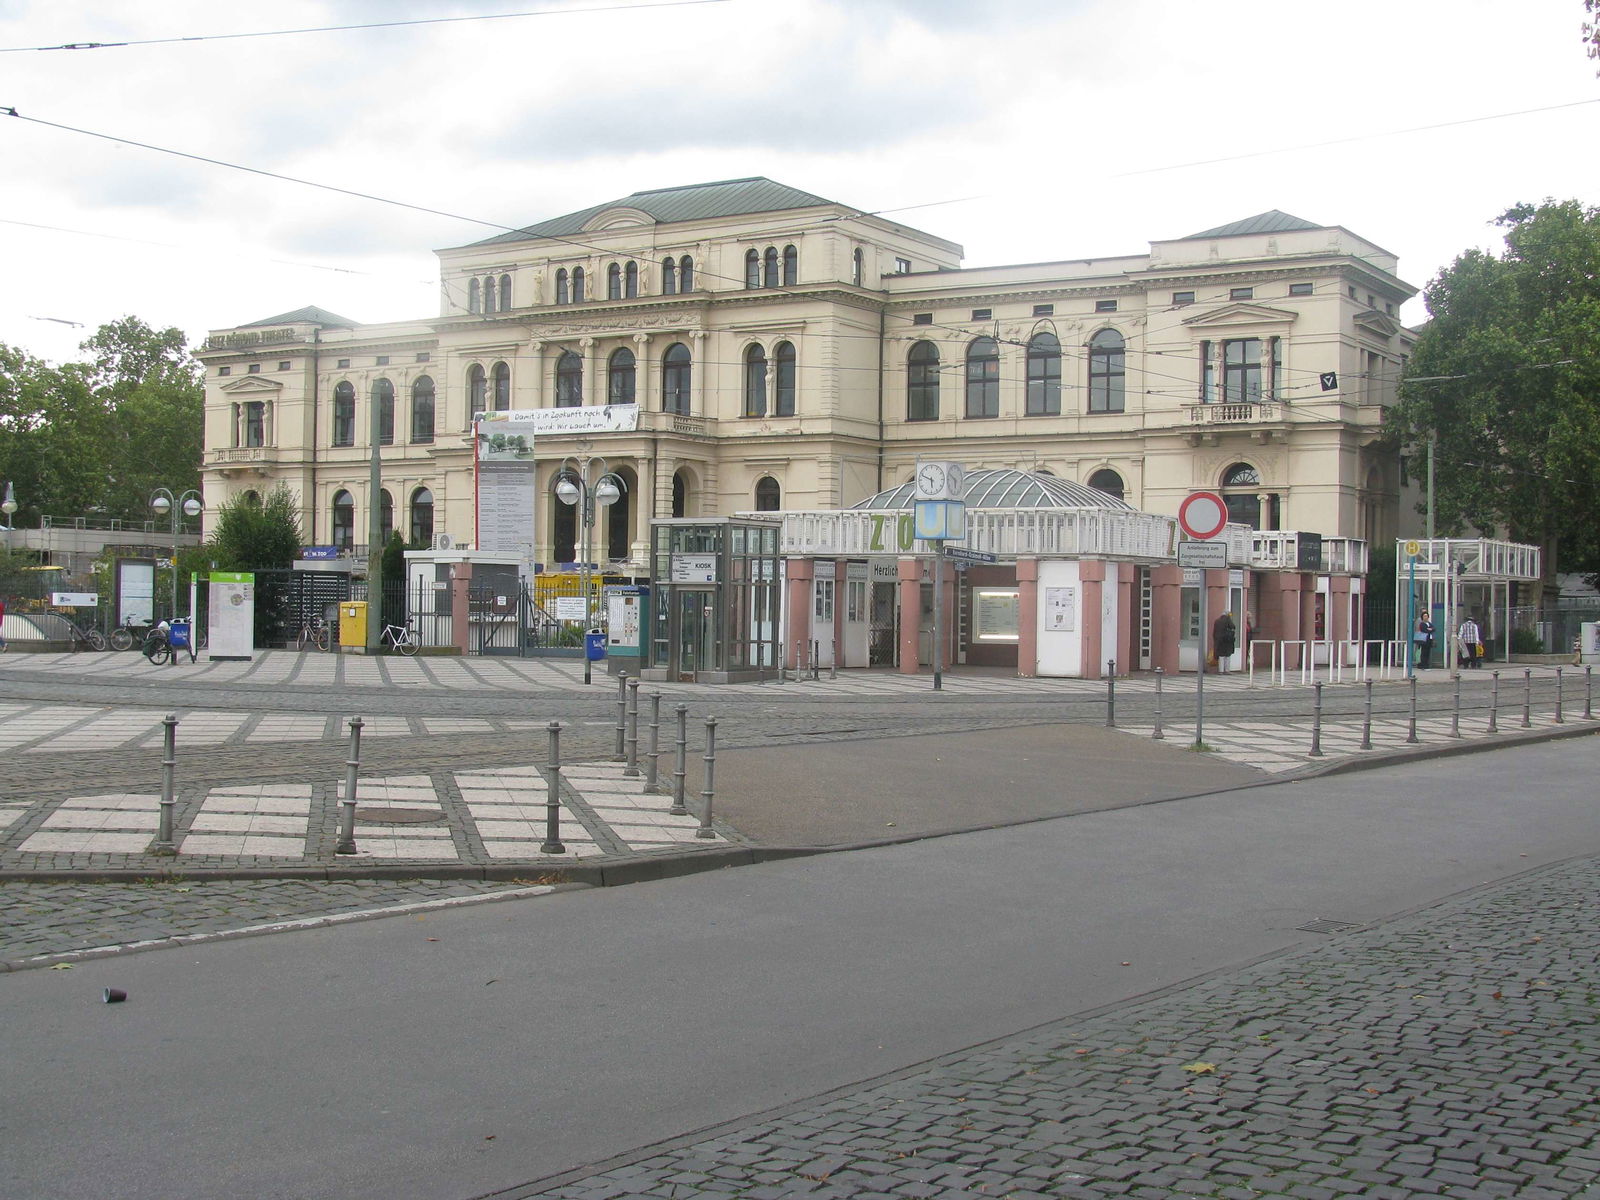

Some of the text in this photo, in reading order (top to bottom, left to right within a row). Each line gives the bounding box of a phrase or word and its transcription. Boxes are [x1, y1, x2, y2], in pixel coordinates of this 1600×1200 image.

[917, 504, 944, 537] U
[948, 504, 962, 536] U
[1408, 543, 1416, 553] H
[874, 564, 899, 577] Herzlich
